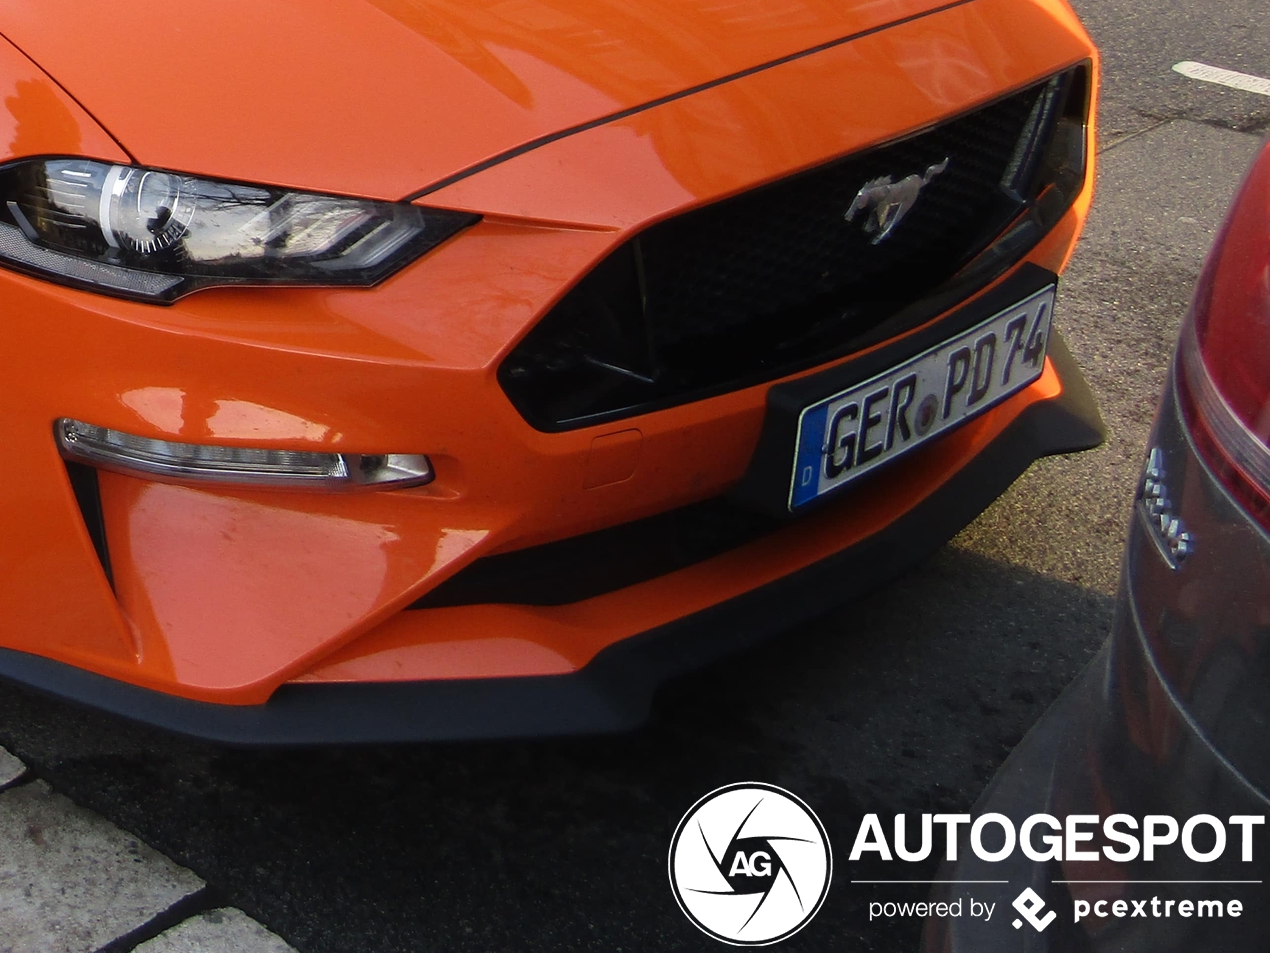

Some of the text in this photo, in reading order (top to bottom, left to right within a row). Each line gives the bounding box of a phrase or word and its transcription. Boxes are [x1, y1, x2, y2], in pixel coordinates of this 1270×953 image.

[825, 301, 1048, 480] GER PD 74
[801, 465, 814, 487] D
